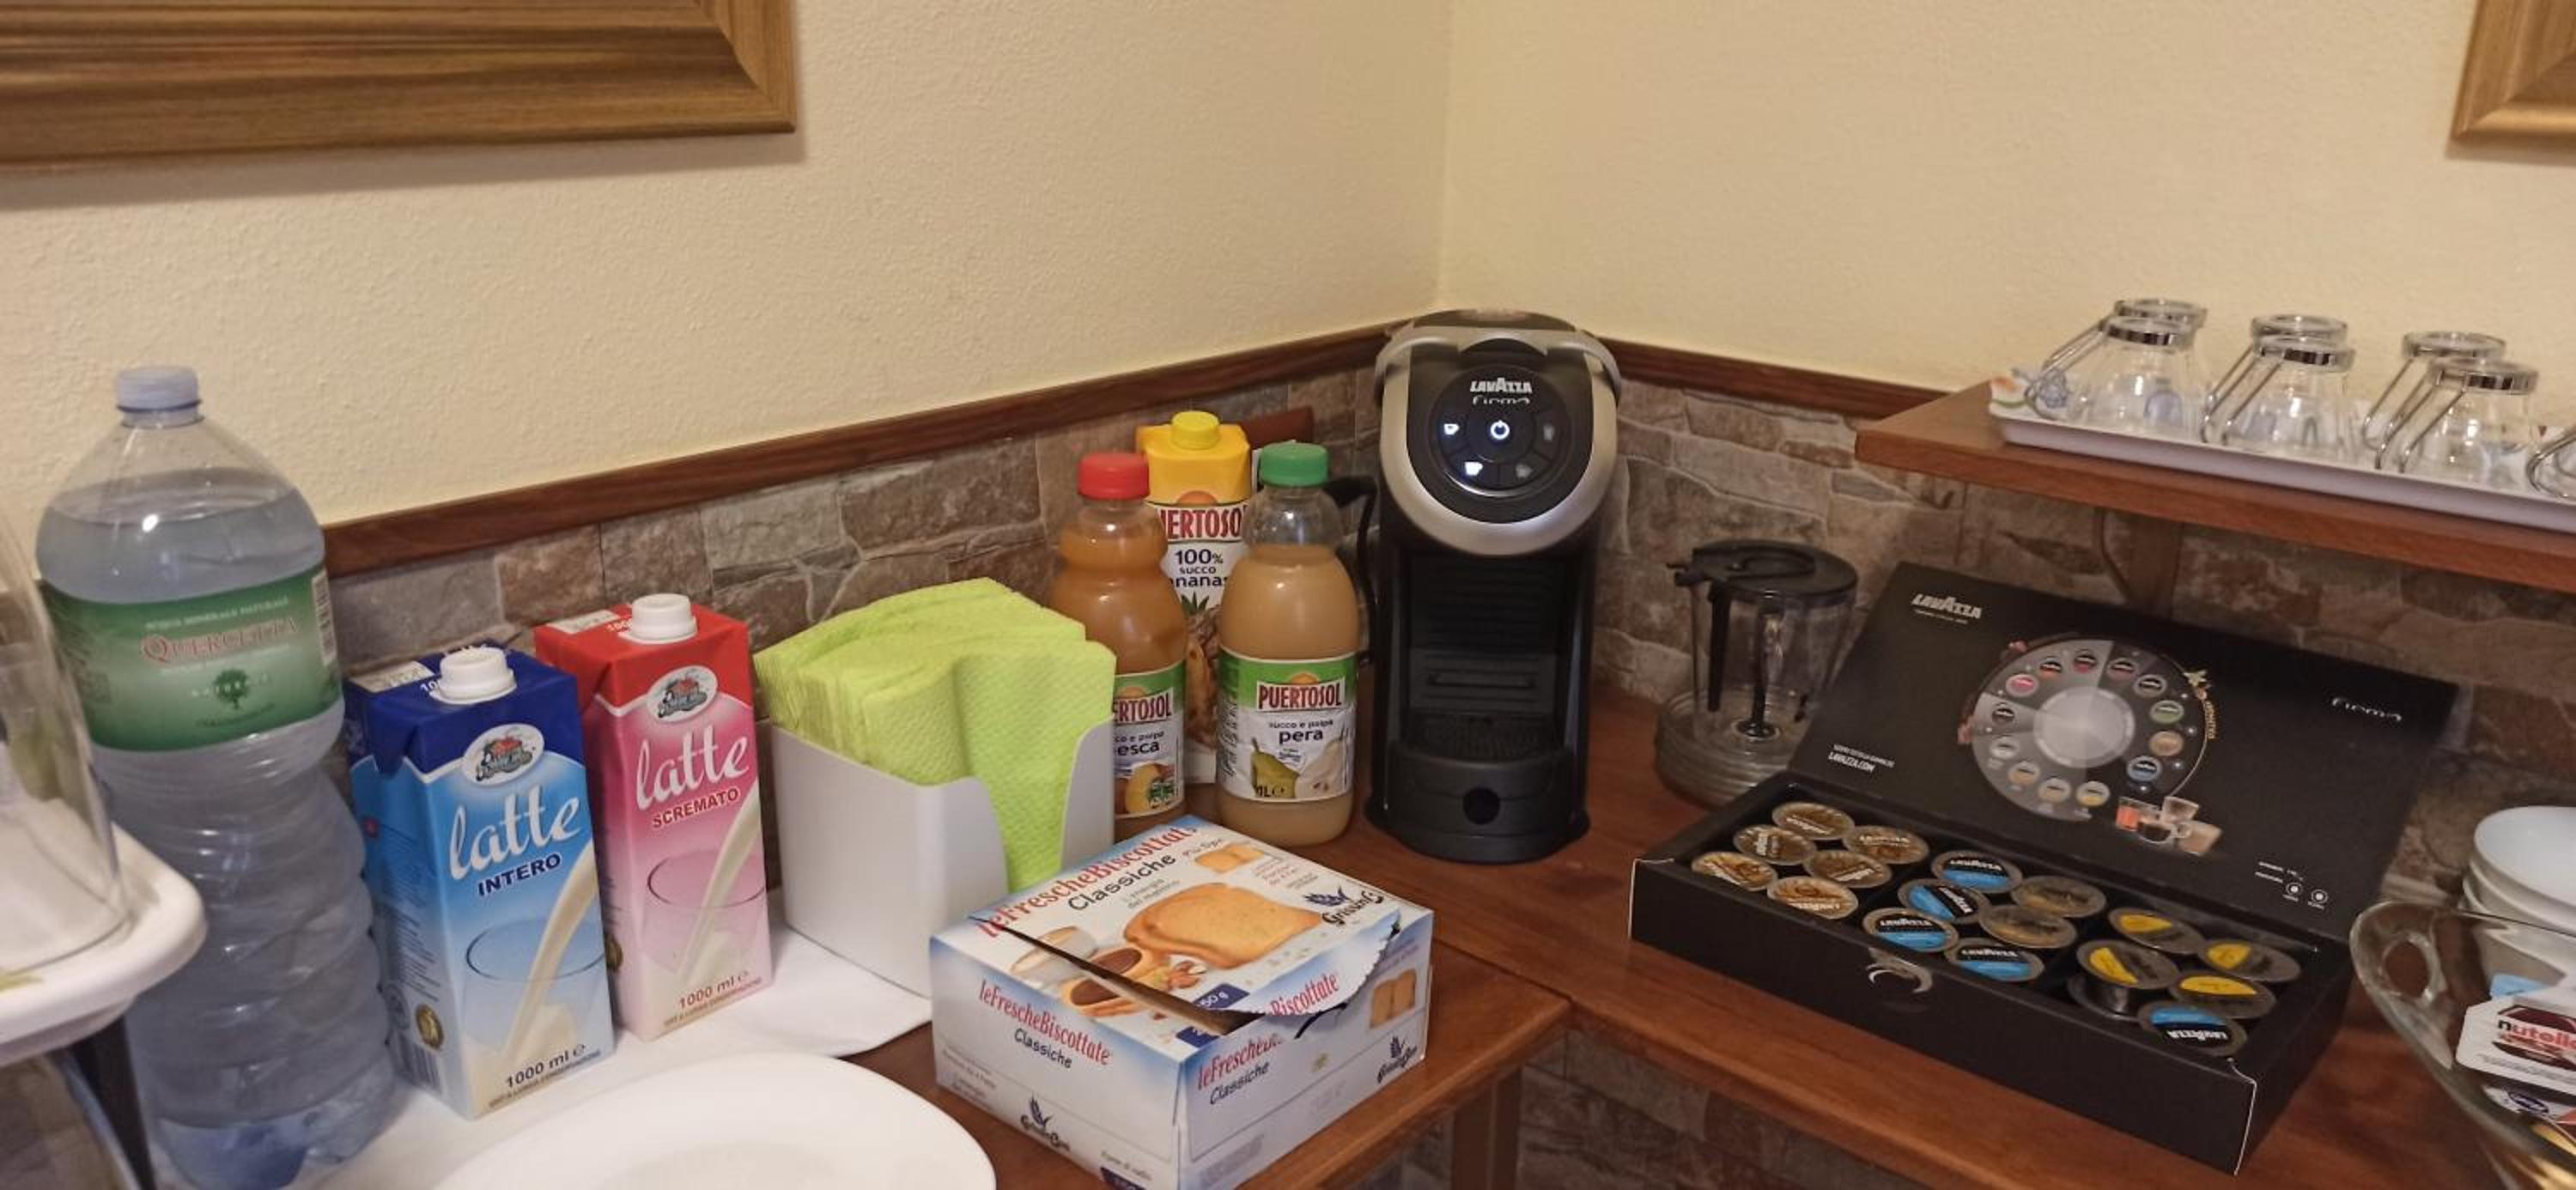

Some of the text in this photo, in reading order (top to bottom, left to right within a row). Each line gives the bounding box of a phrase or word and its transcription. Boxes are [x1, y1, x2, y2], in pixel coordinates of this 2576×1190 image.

[1469, 377, 1533, 394] LAVAZZA
[1161, 504, 1248, 539] ERTOSO
[1175, 549, 1224, 565] 100%
[1179, 566, 1217, 574] succo
[1911, 593, 1983, 619] LAVAZZA
[1258, 682, 1343, 710] PUERTOSOL
[1114, 741, 1160, 756] esca
[1279, 730, 1323, 745] pera
[636, 725, 750, 811] latte
[653, 787, 740, 829] SCREMATO
[449, 785, 581, 880] latte
[477, 853, 562, 896] INTERO
[1067, 853, 1176, 911] Classiche
[679, 986, 714, 1010] 1000
[717, 974, 734, 993] ml
[978, 979, 1111, 1066] leFrescheBiscottate
[1014, 1028, 1073, 1070] Classiche
[506, 1061, 545, 1089] 1000
[549, 1050, 569, 1069] ml
[1209, 1061, 1270, 1106] Classiche
